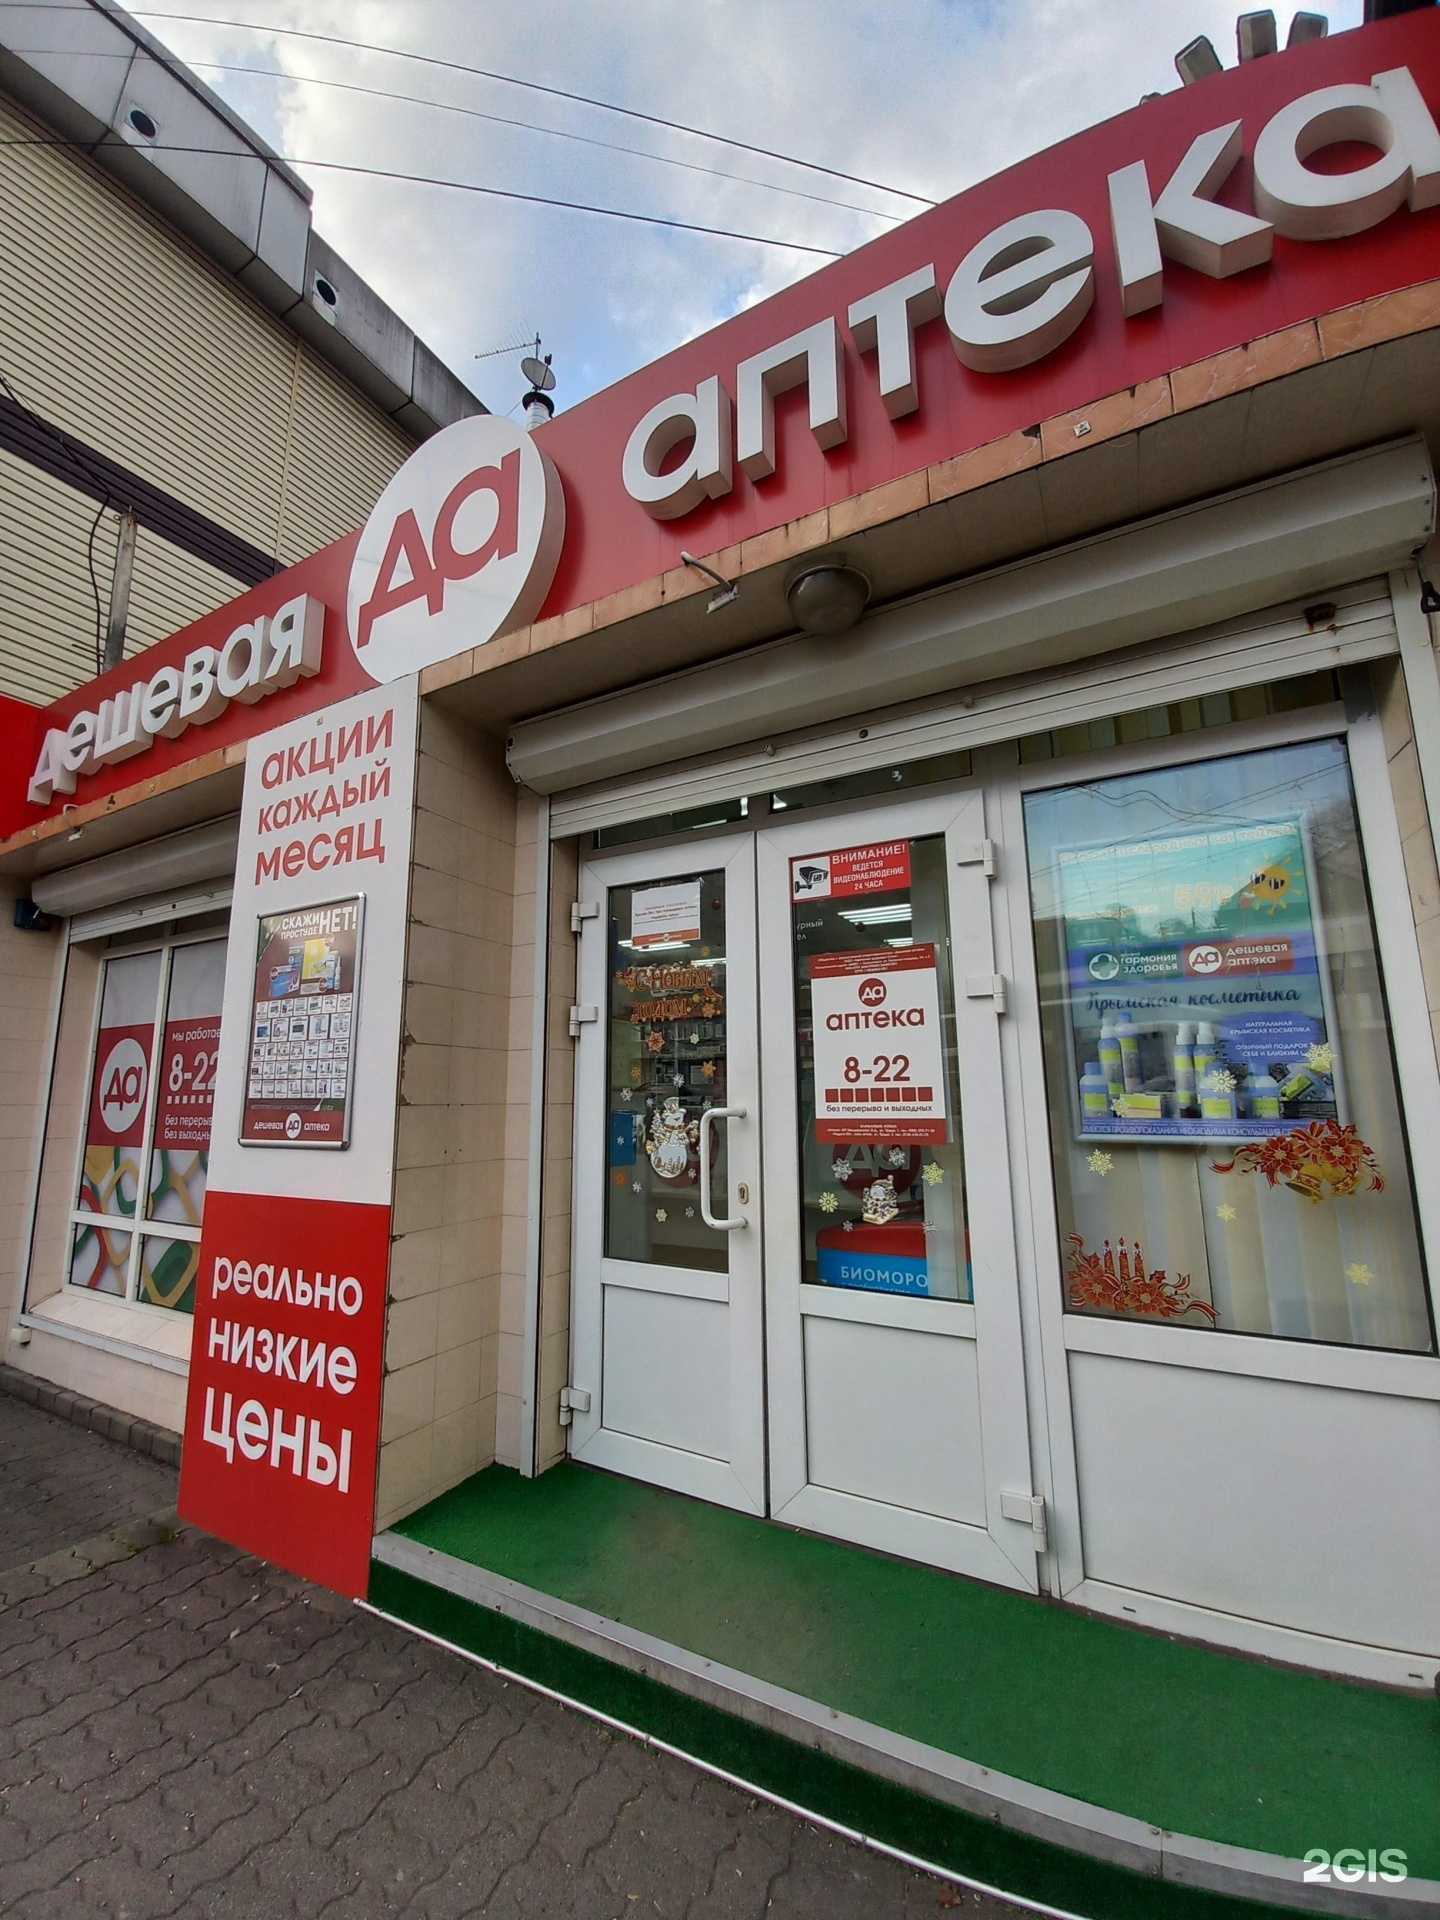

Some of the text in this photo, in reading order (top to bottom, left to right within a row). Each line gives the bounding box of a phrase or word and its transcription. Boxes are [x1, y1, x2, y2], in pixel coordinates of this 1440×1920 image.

[622, 65, 1440, 510] аптека
[261, 708, 394, 790] акции
[258, 757, 391, 835] каждый
[255, 818, 386, 887] месяц
[832, 843, 906, 865] ВНИМАНИЕ!
[833, 866, 905, 885] ВИДЕОНАБЛЮДЕНИЕ
[852, 860, 884, 872] ВЕДЕТСЯ
[854, 879, 884, 891] 24 ЧАСА
[282, 904, 358, 935] СКАЖИ НЕТ!
[280, 925, 321, 941] ПРОСТУДЕ
[1187, 989, 1303, 1007] косметика
[826, 1007, 925, 1032] аптека
[843, 1054, 911, 1084] 8-22
[164, 1113, 179, 1126] без
[826, 1104, 841, 1113] без
[841, 1105, 882, 1114] перерыва
[891, 1104, 933, 1113] выходных
[163, 1127, 178, 1140] без
[211, 1255, 363, 1317] реально
[208, 1317, 359, 1396] низкие
[202, 1386, 352, 1495] цены
